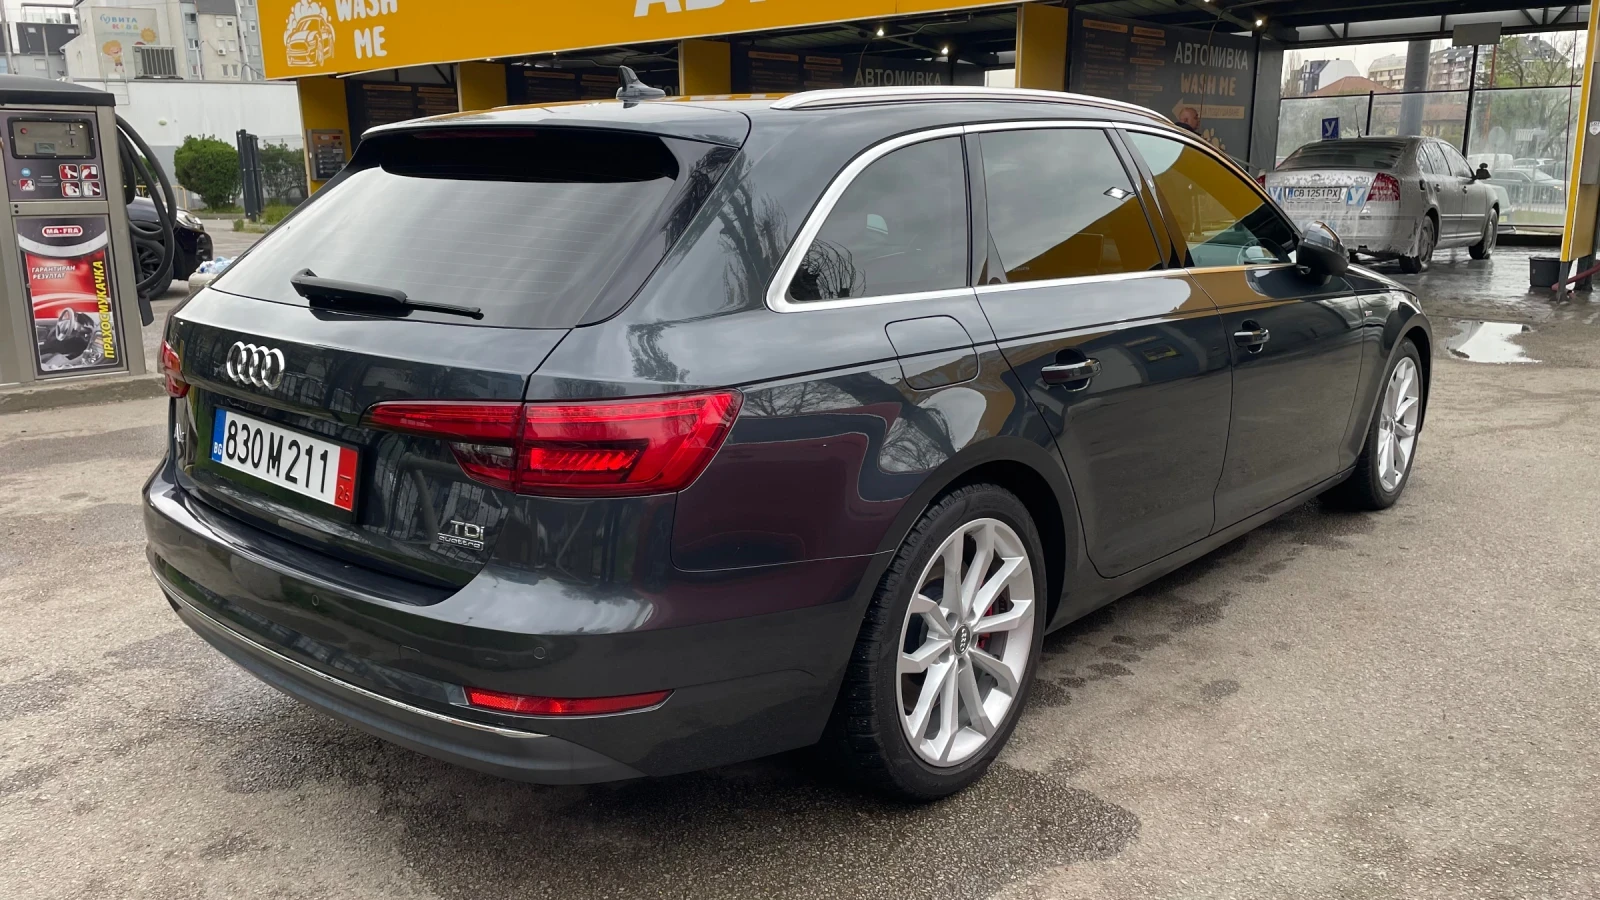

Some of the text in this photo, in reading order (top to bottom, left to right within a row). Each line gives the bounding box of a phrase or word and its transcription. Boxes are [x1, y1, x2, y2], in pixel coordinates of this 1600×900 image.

[354, 26, 388, 59] ME
[1174, 41, 1249, 70] АВТОМИВКА
[854, 68, 942, 86] АВТОМИВКА
[1180, 72, 1237, 96] WASH ME
[31, 265, 76, 273] ГАРАНТИРАН
[93, 261, 114, 358] ПРАХОСМУКАЧКА
[213, 441, 223, 455] BG
[337, 484, 351, 502] 26
[438, 535, 481, 549] quattro
